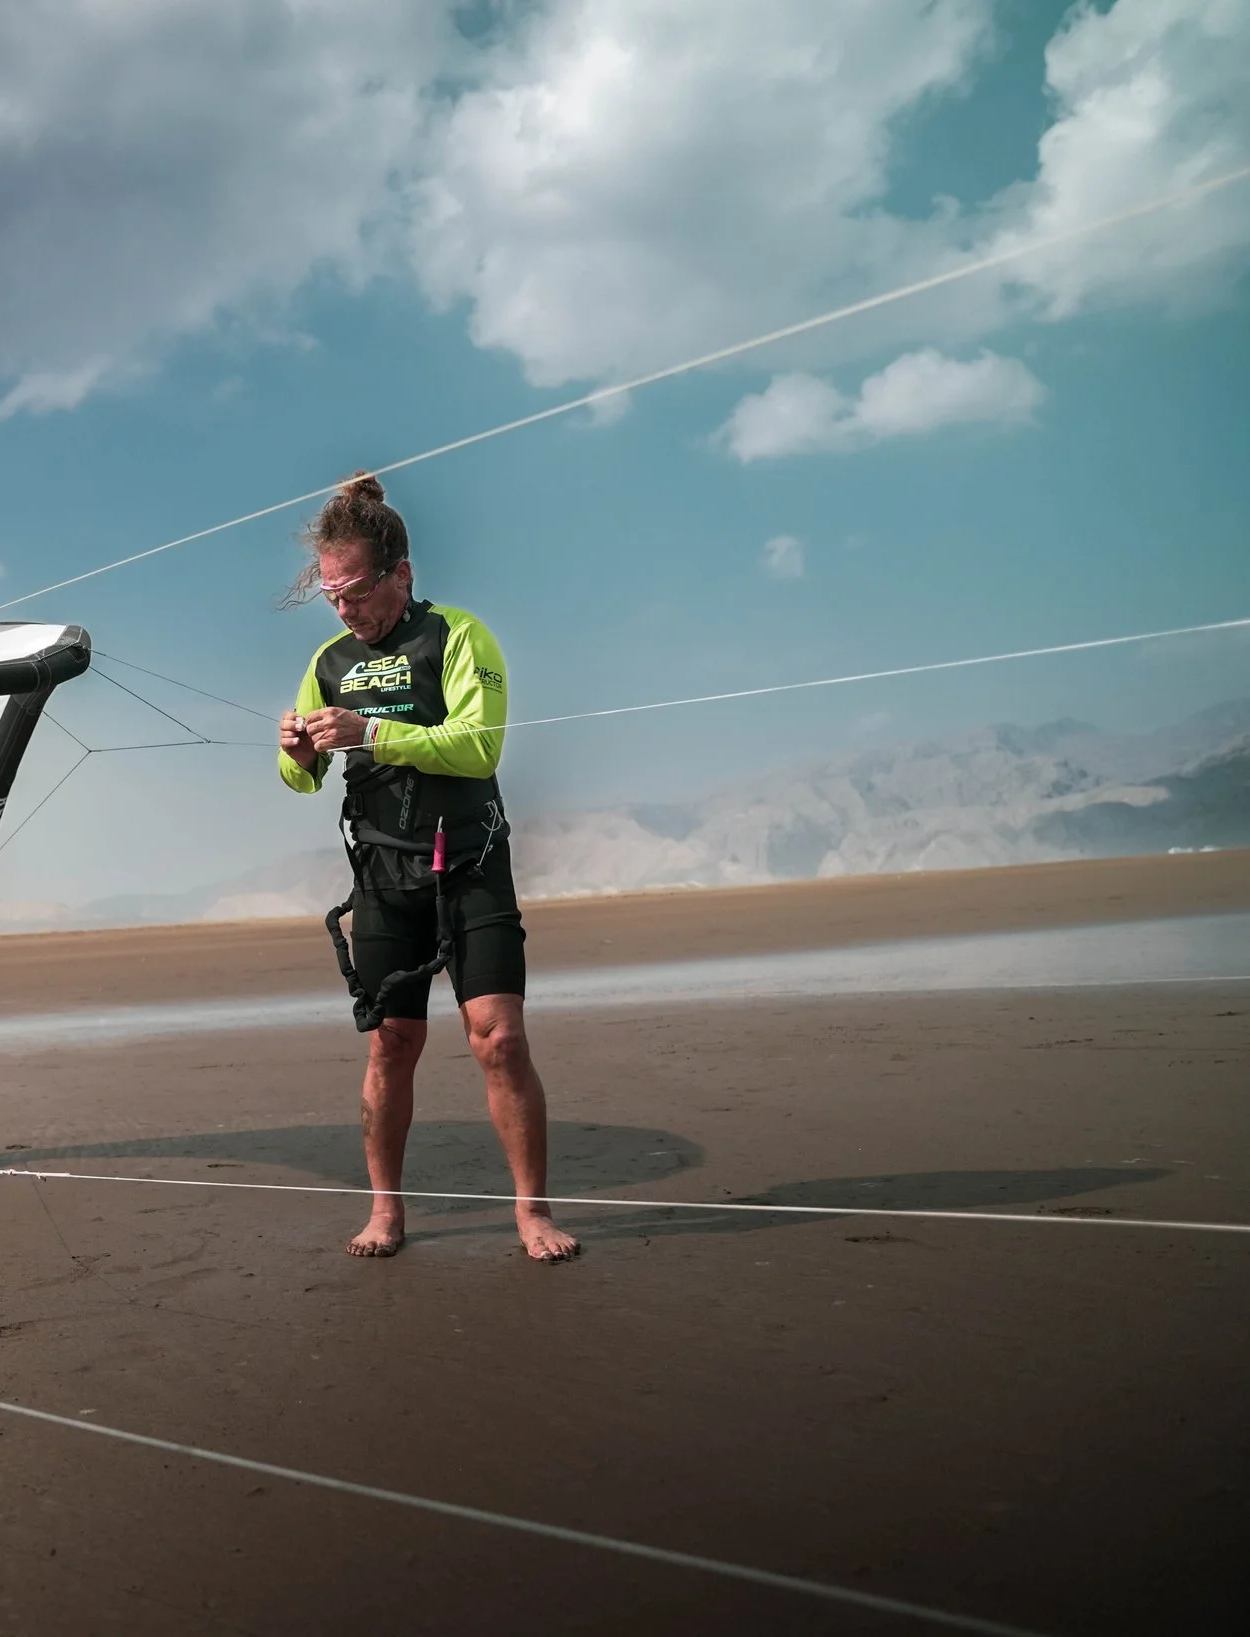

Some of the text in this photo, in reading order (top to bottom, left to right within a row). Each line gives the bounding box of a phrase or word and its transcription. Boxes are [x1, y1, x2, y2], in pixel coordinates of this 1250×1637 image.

[364, 655, 409, 672] SEA
[340, 671, 412, 694] BEACH
[380, 685, 412, 693] LIFESTYLE
